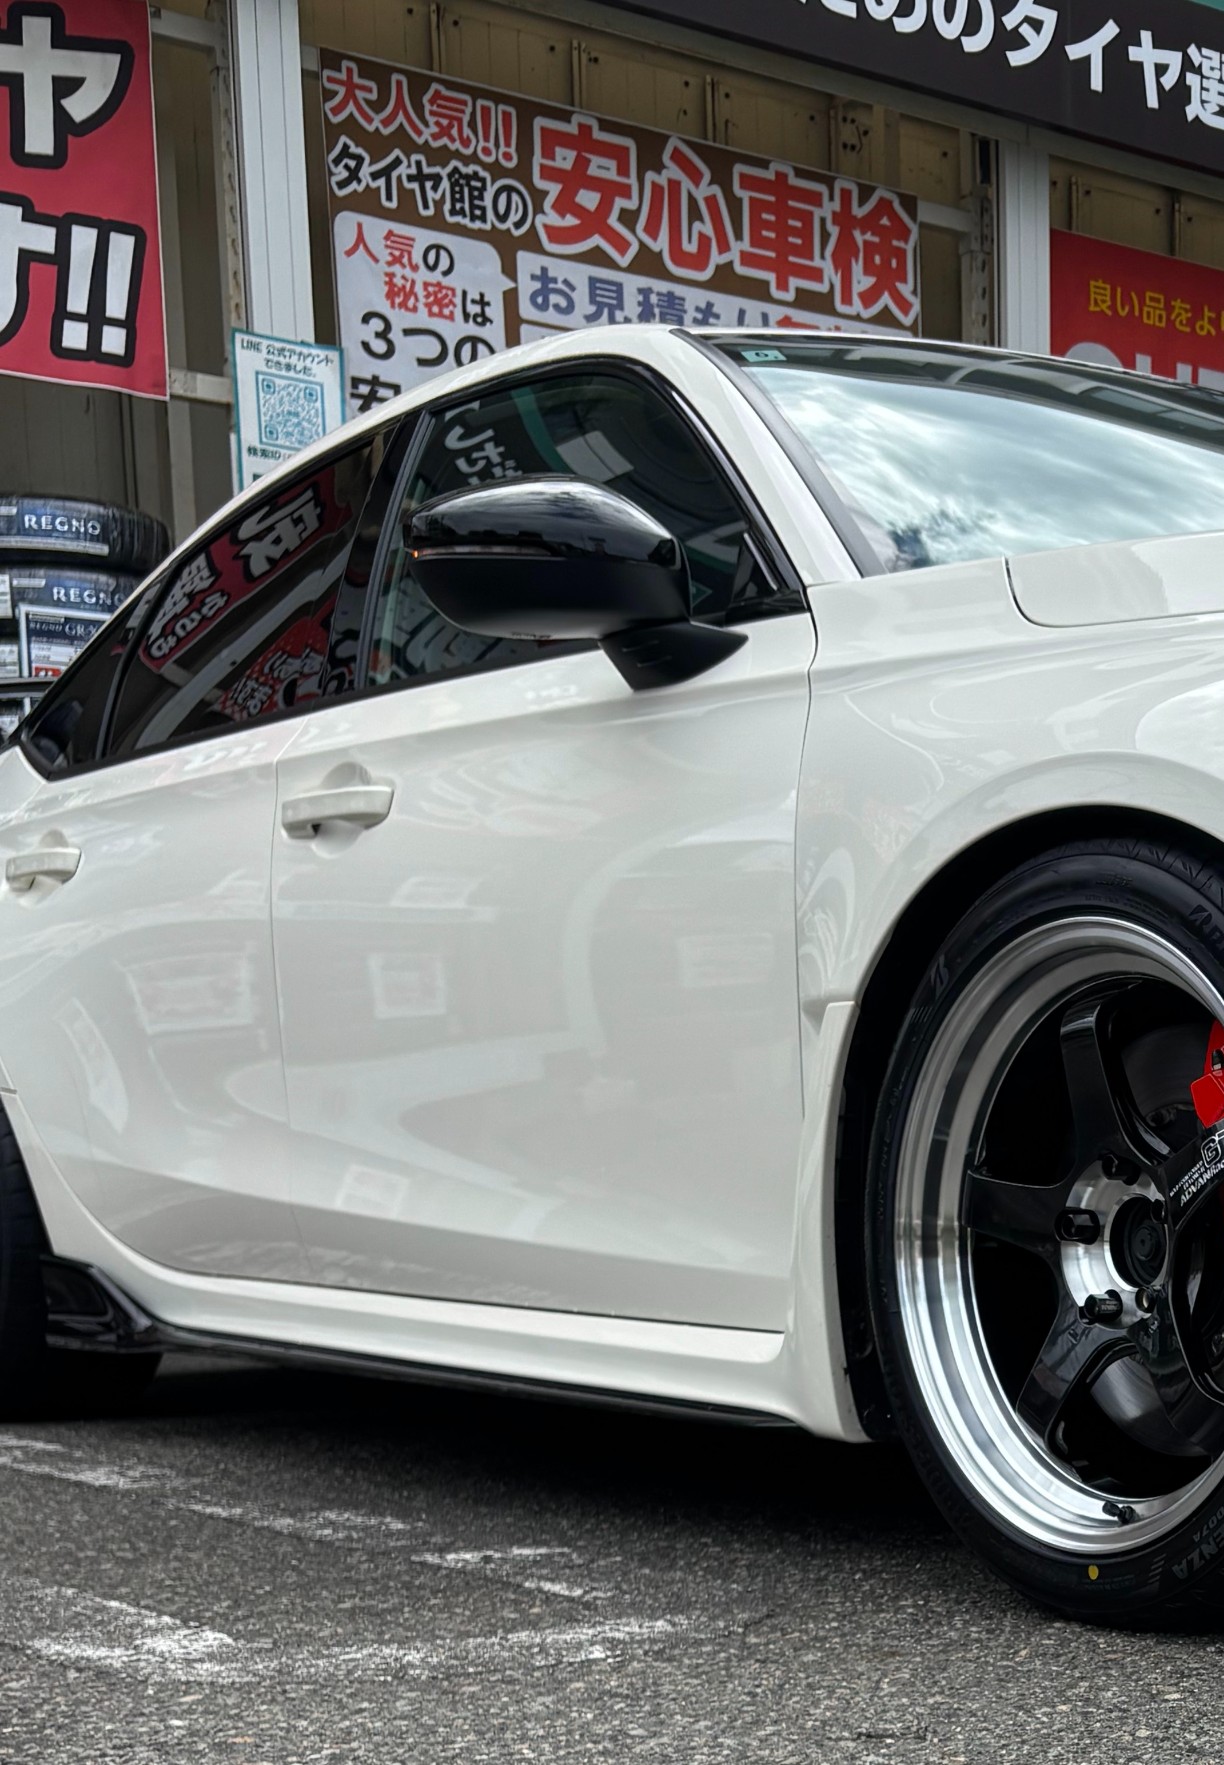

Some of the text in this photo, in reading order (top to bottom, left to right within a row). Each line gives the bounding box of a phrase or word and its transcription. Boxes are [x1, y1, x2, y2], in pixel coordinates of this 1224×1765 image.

[325, 64, 515, 163] 大人気!!
[330, 142, 530, 231] タイヤ館の
[538, 118, 915, 320] 安心車検
[344, 222, 455, 277] 人気の
[384, 271, 494, 326] 秘密は
[241, 338, 262, 353] LINE
[24, 514, 101, 536] REGNO
